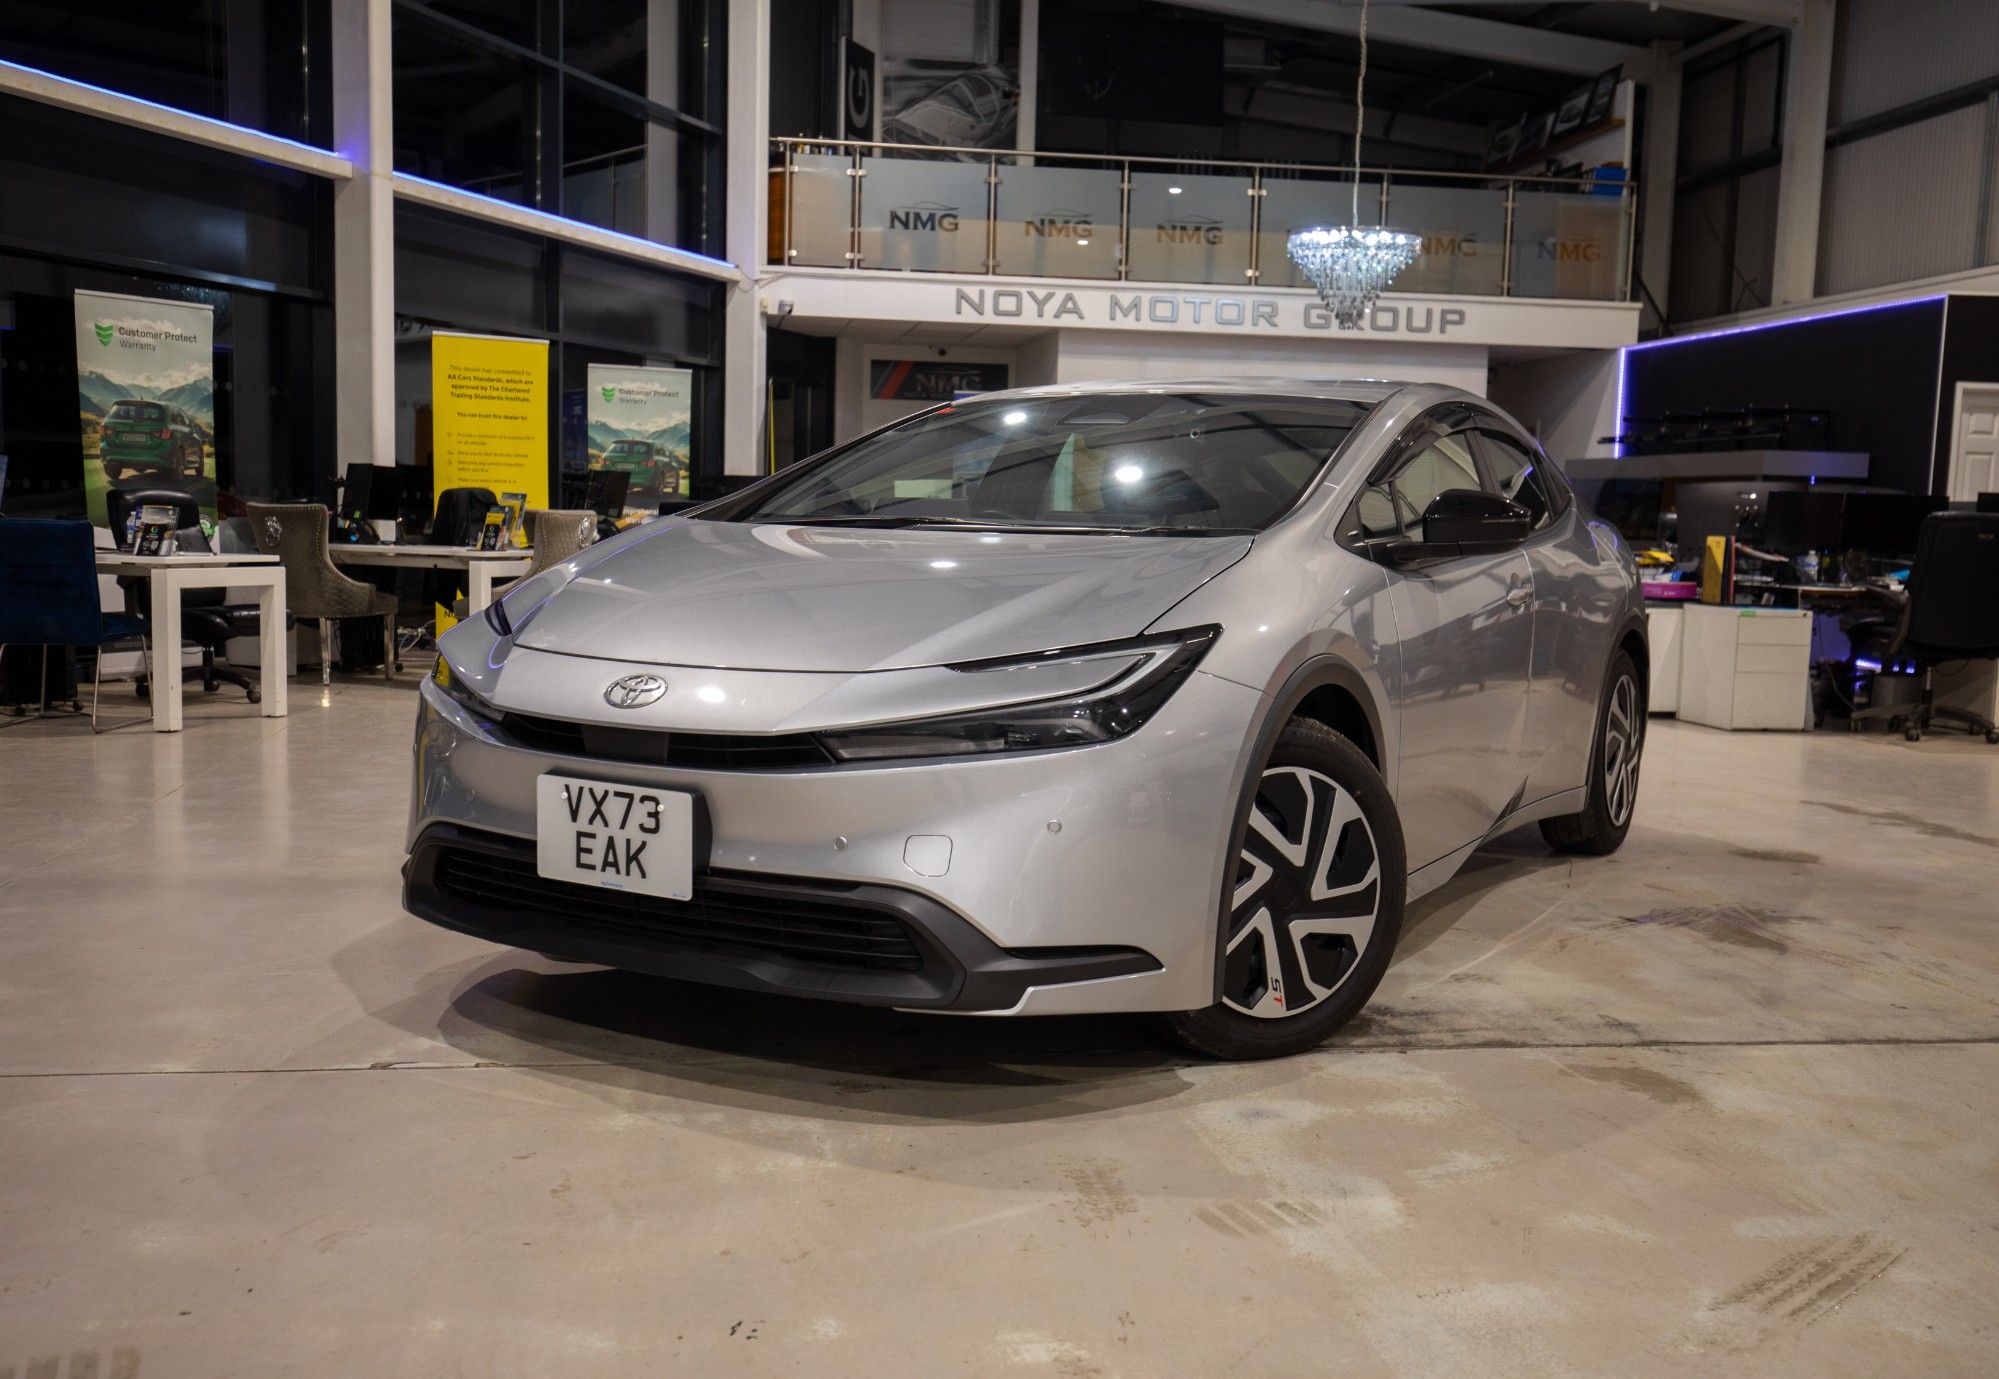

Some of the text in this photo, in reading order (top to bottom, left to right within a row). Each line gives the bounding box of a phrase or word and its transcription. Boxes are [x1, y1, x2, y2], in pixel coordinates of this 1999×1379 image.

[889, 210, 959, 232] NMG
[1024, 218, 1093, 238] NMG
[1156, 224, 1223, 245] NMG
[1538, 240, 1600, 261] NMG
[956, 288, 1085, 319] NOYA
[1109, 294, 1279, 327] MOTOR
[118, 327, 198, 343] Customer Protect
[120, 340, 156, 352] Warranty
[474, 393, 505, 401] Standards
[480, 384, 488, 392] by
[619, 388, 679, 398] Customer Protect
[564, 784, 661, 834] VX73
[576, 831, 647, 879] EAK
[1270, 977, 1283, 1008] ST
